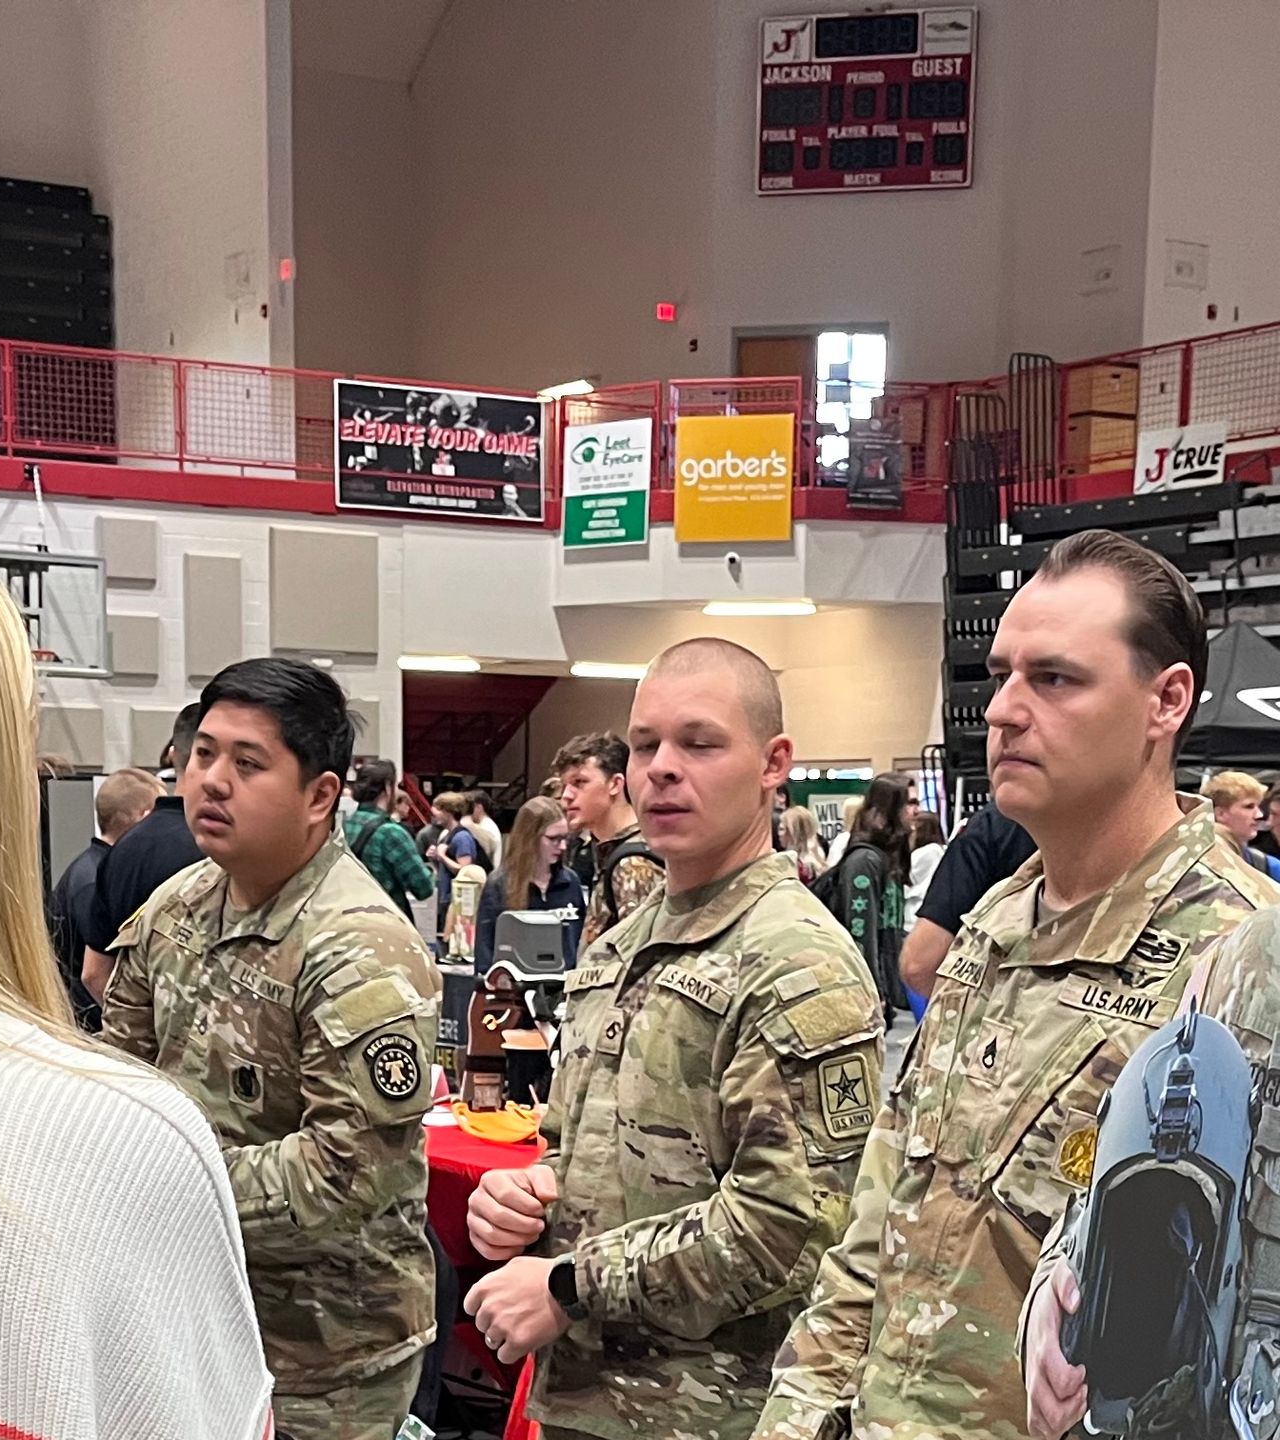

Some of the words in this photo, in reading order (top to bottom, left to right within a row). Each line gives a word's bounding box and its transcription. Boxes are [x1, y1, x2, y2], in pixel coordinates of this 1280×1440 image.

[763, 65, 832, 84] JACKSON
[911, 57, 963, 77] GUEST
[340, 418, 427, 448] ELEVATE
[427, 425, 481, 453] YOUR
[680, 449, 787, 487] garber's
[1173, 443, 1224, 470] CRUE
[677, 974, 719, 1005] ARMY
[1082, 985, 1112, 1012] U.S.
[1112, 993, 1159, 1020] ARMY
